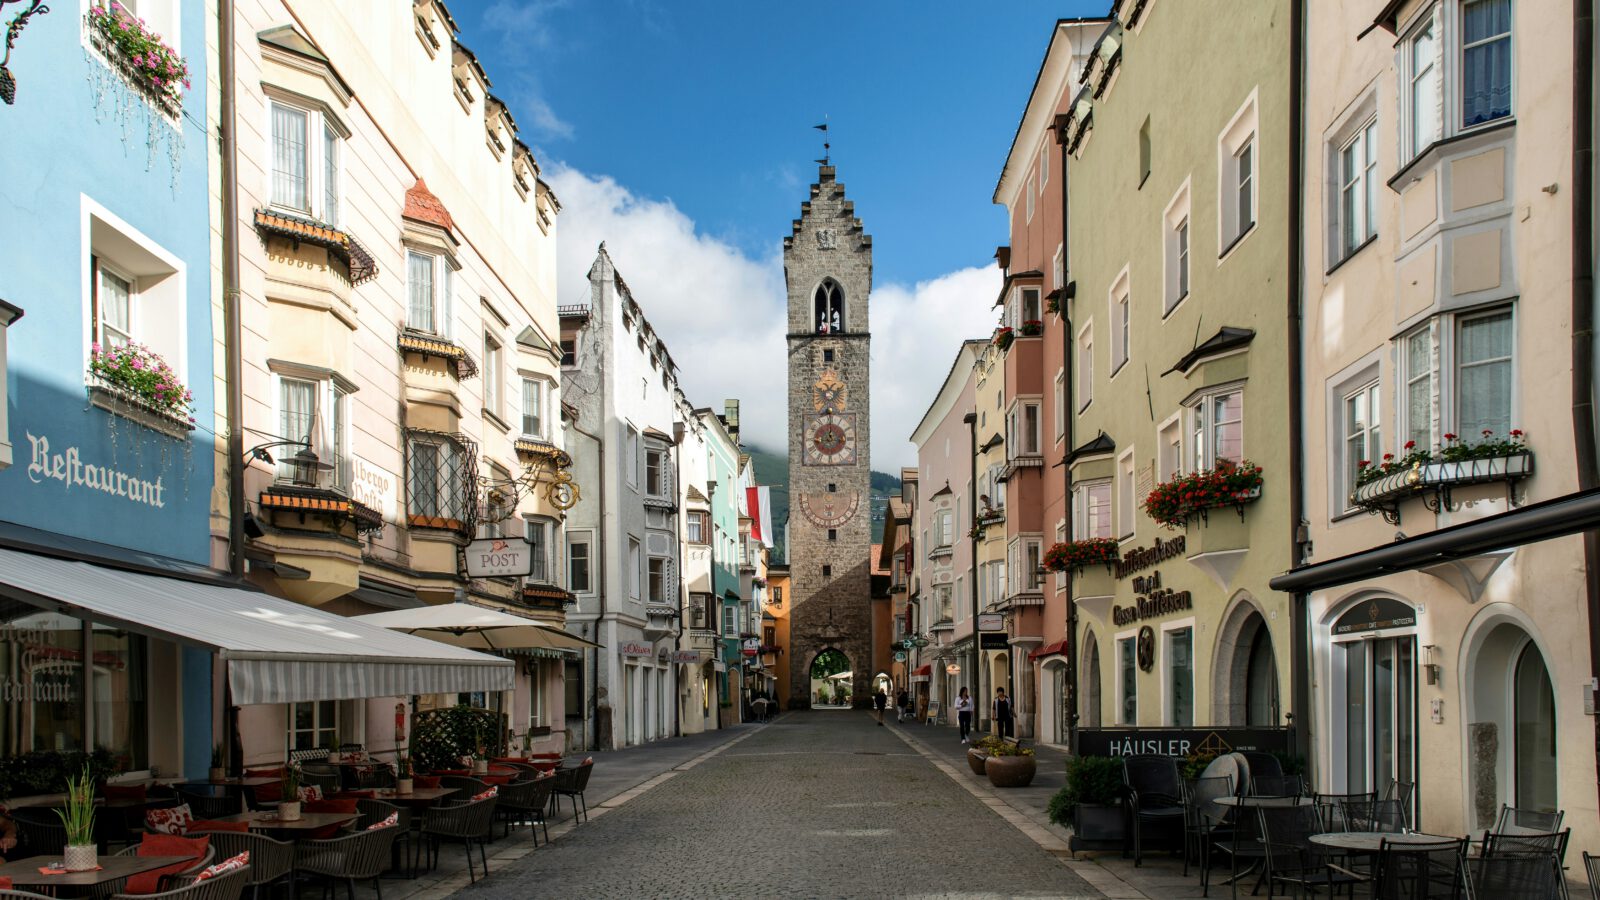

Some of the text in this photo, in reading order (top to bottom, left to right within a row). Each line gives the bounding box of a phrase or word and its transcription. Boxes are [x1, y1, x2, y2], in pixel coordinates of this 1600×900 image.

[352, 460, 389, 496] lbergo
[480, 553, 519, 568] POST
[1113, 588, 1192, 626] Cassa Raiffeisen
[1110, 737, 1191, 756] HÄUSLER
